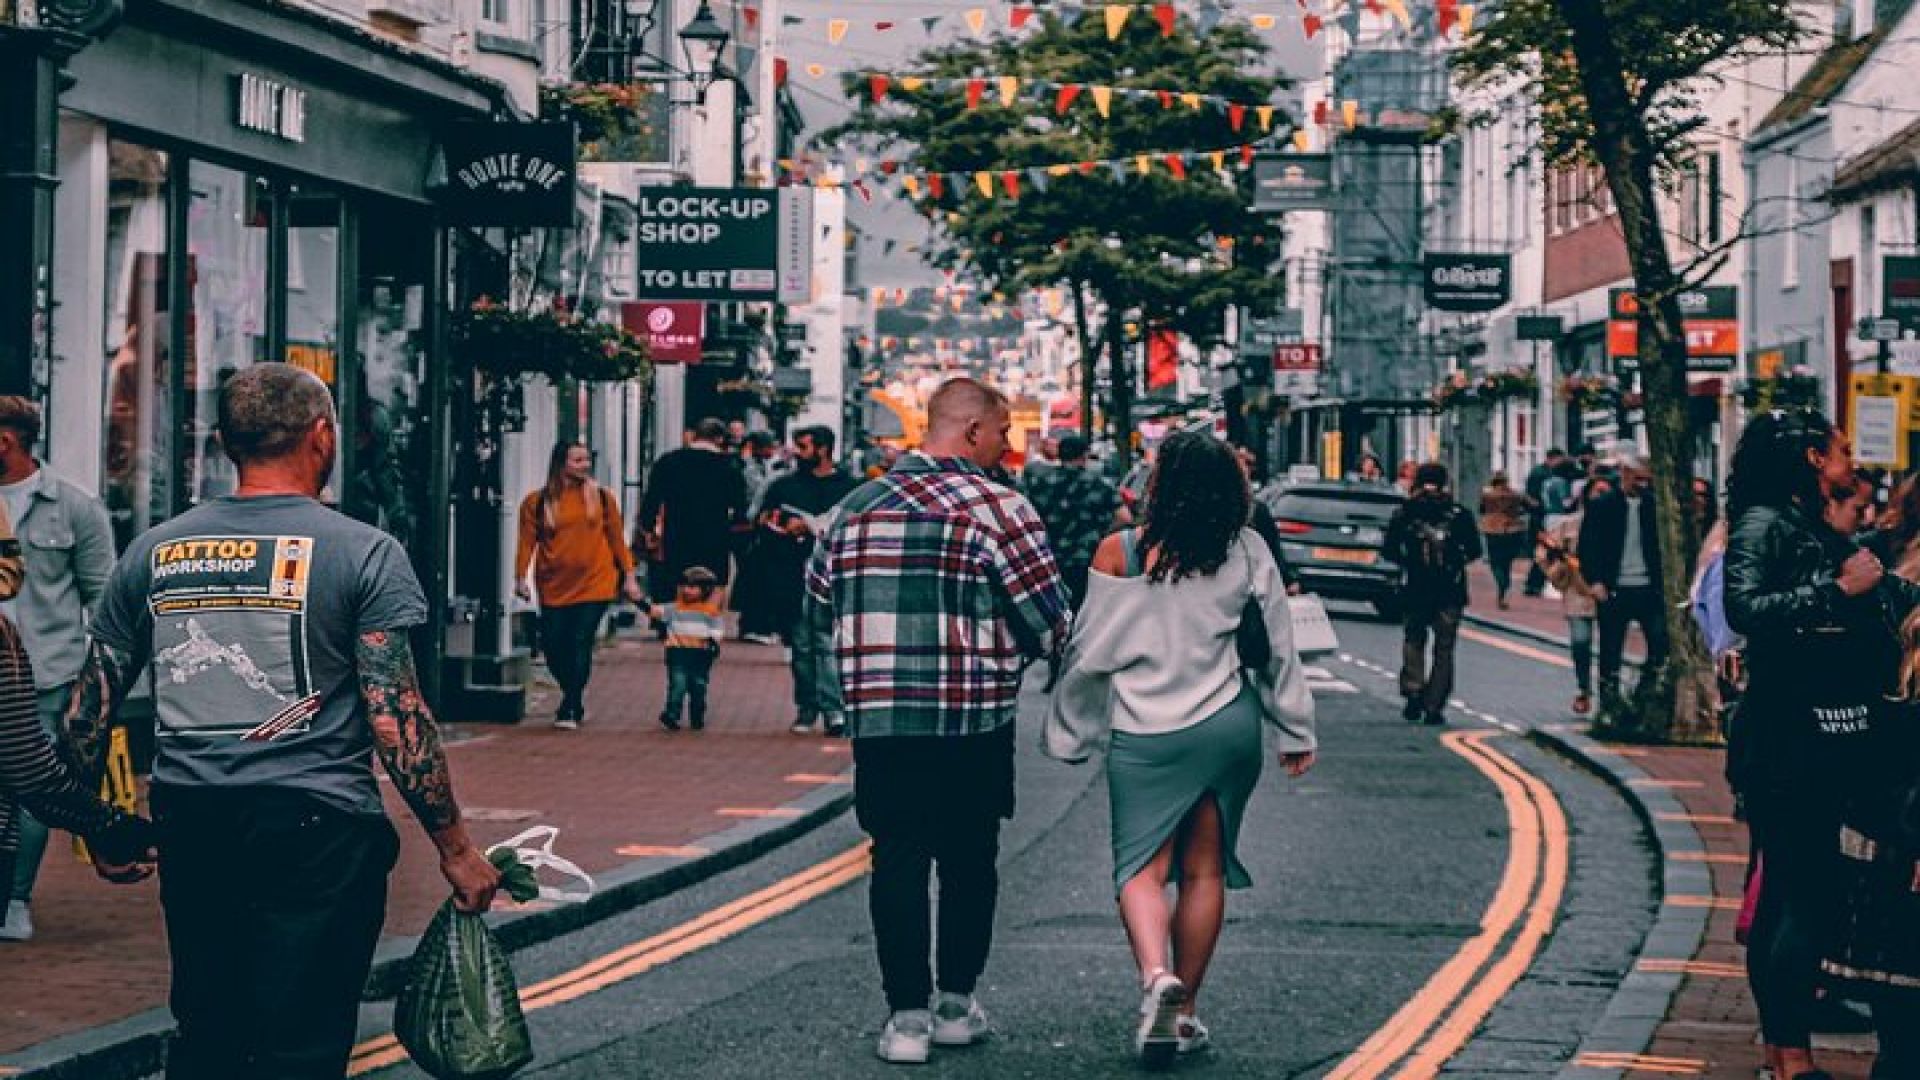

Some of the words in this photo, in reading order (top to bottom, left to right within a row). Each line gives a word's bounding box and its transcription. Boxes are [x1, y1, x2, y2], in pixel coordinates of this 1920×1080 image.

[458, 152, 520, 190] ROUTE
[525, 157, 566, 190] ONE
[640, 197, 771, 219] LOCK-UP
[640, 222, 721, 244] SHOP
[640, 269, 677, 288] TO
[682, 269, 727, 289] LET
[1279, 349, 1304, 363] TO
[159, 540, 257, 566] TATTOO
[153, 558, 257, 579] WORKSHOP
